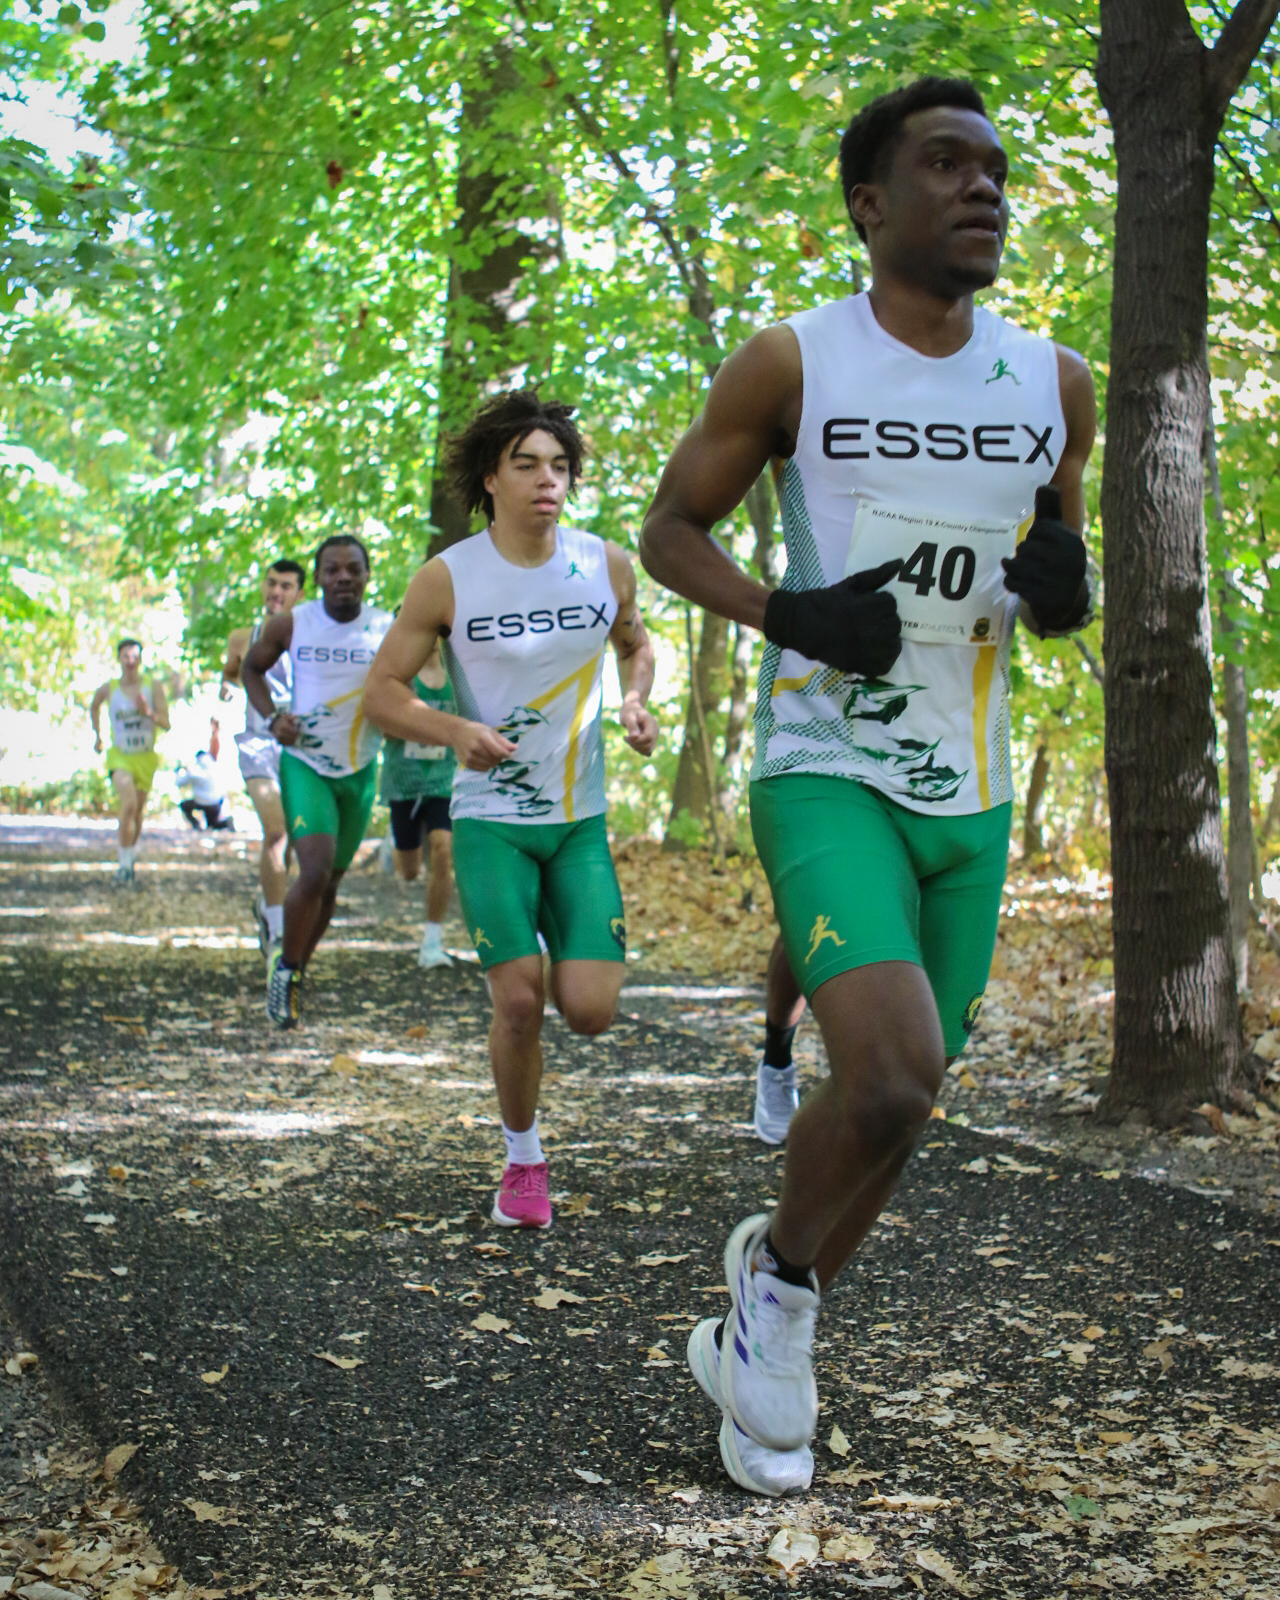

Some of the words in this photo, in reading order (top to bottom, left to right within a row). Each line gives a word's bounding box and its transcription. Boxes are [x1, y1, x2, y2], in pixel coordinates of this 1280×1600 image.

[822, 418, 1054, 467] ESSEX
[872, 508, 897, 520] NJCAA
[898, 513, 923, 525] Region
[898, 541, 976, 602] 40
[467, 602, 609, 643] ESSEX
